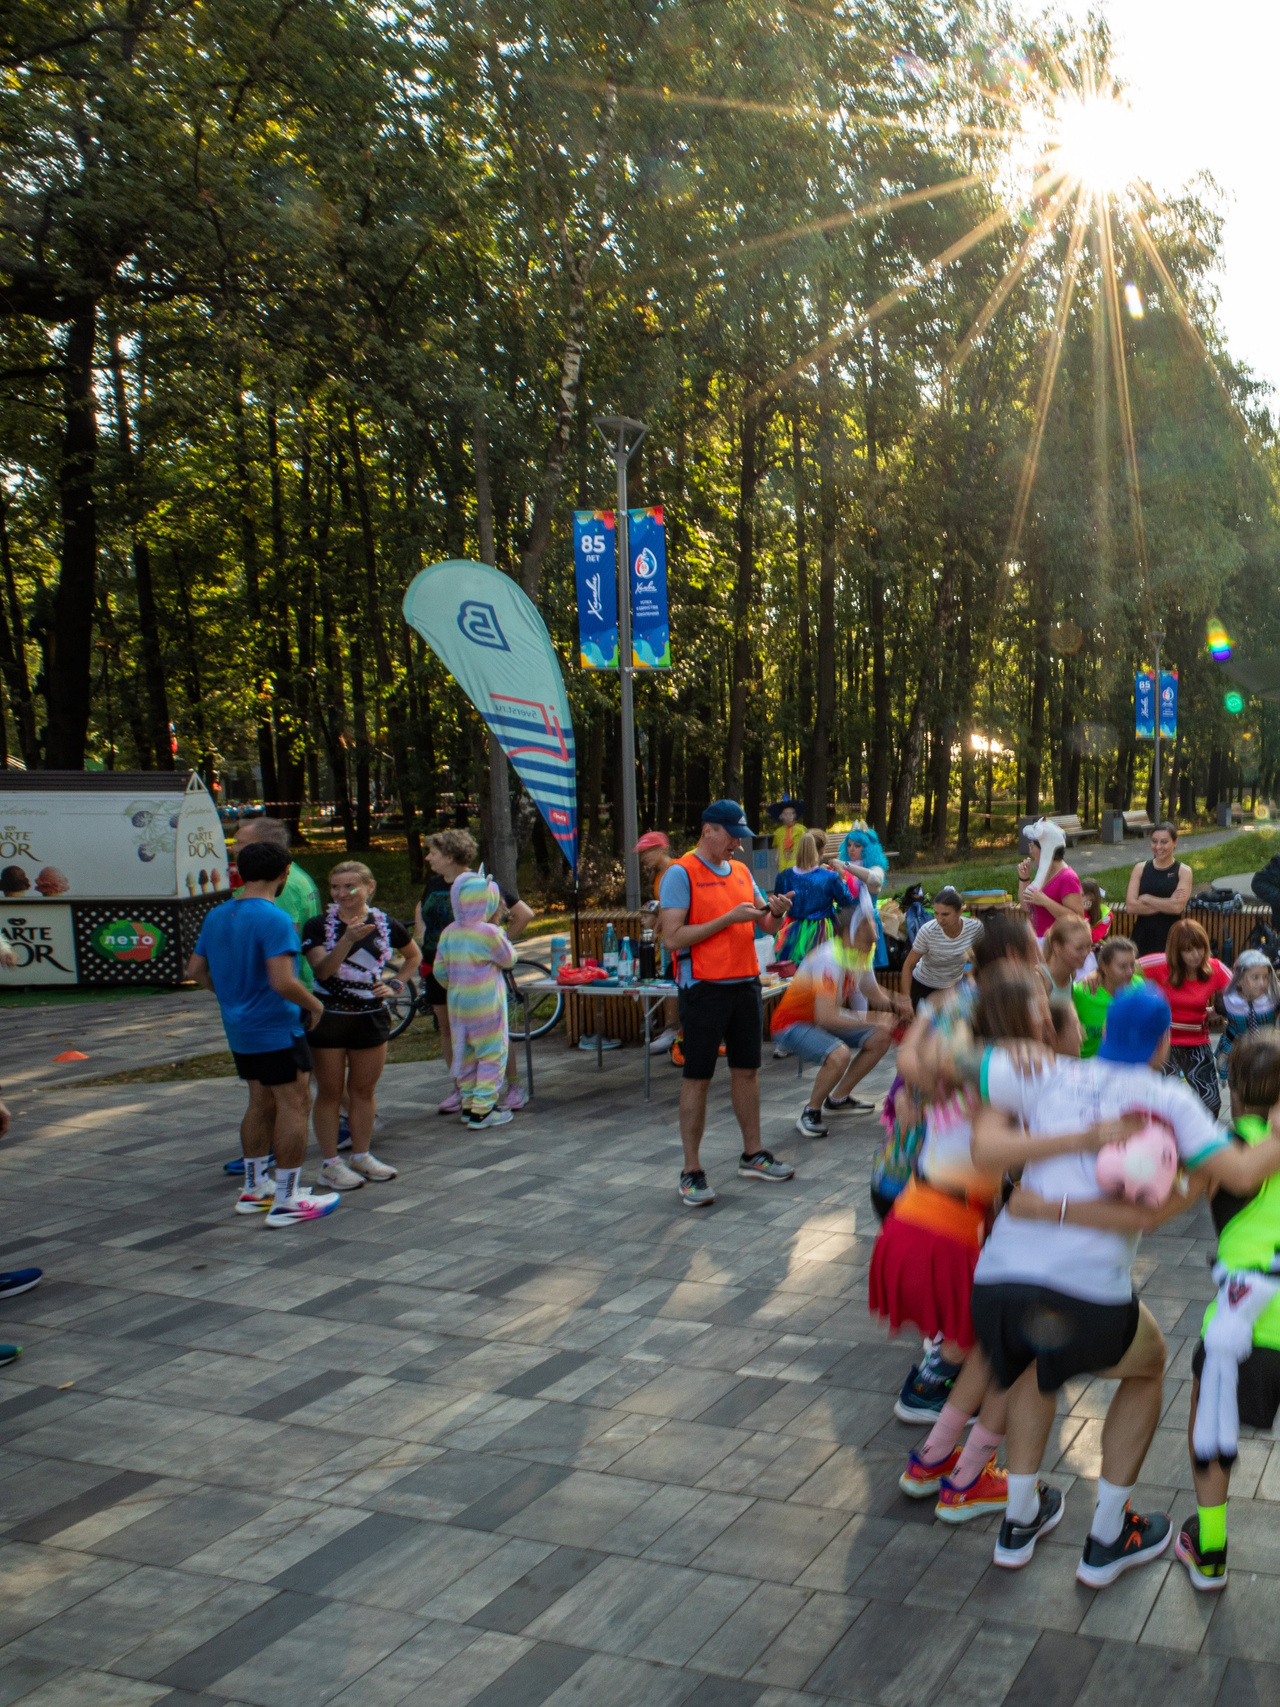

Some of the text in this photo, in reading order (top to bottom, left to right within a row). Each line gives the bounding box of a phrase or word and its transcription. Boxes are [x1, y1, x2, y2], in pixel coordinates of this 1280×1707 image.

[581, 535, 606, 553] 85
[586, 554, 600, 562] ЛЕТ
[187, 831, 213, 844] CARTE
[104, 934, 154, 946] лето
